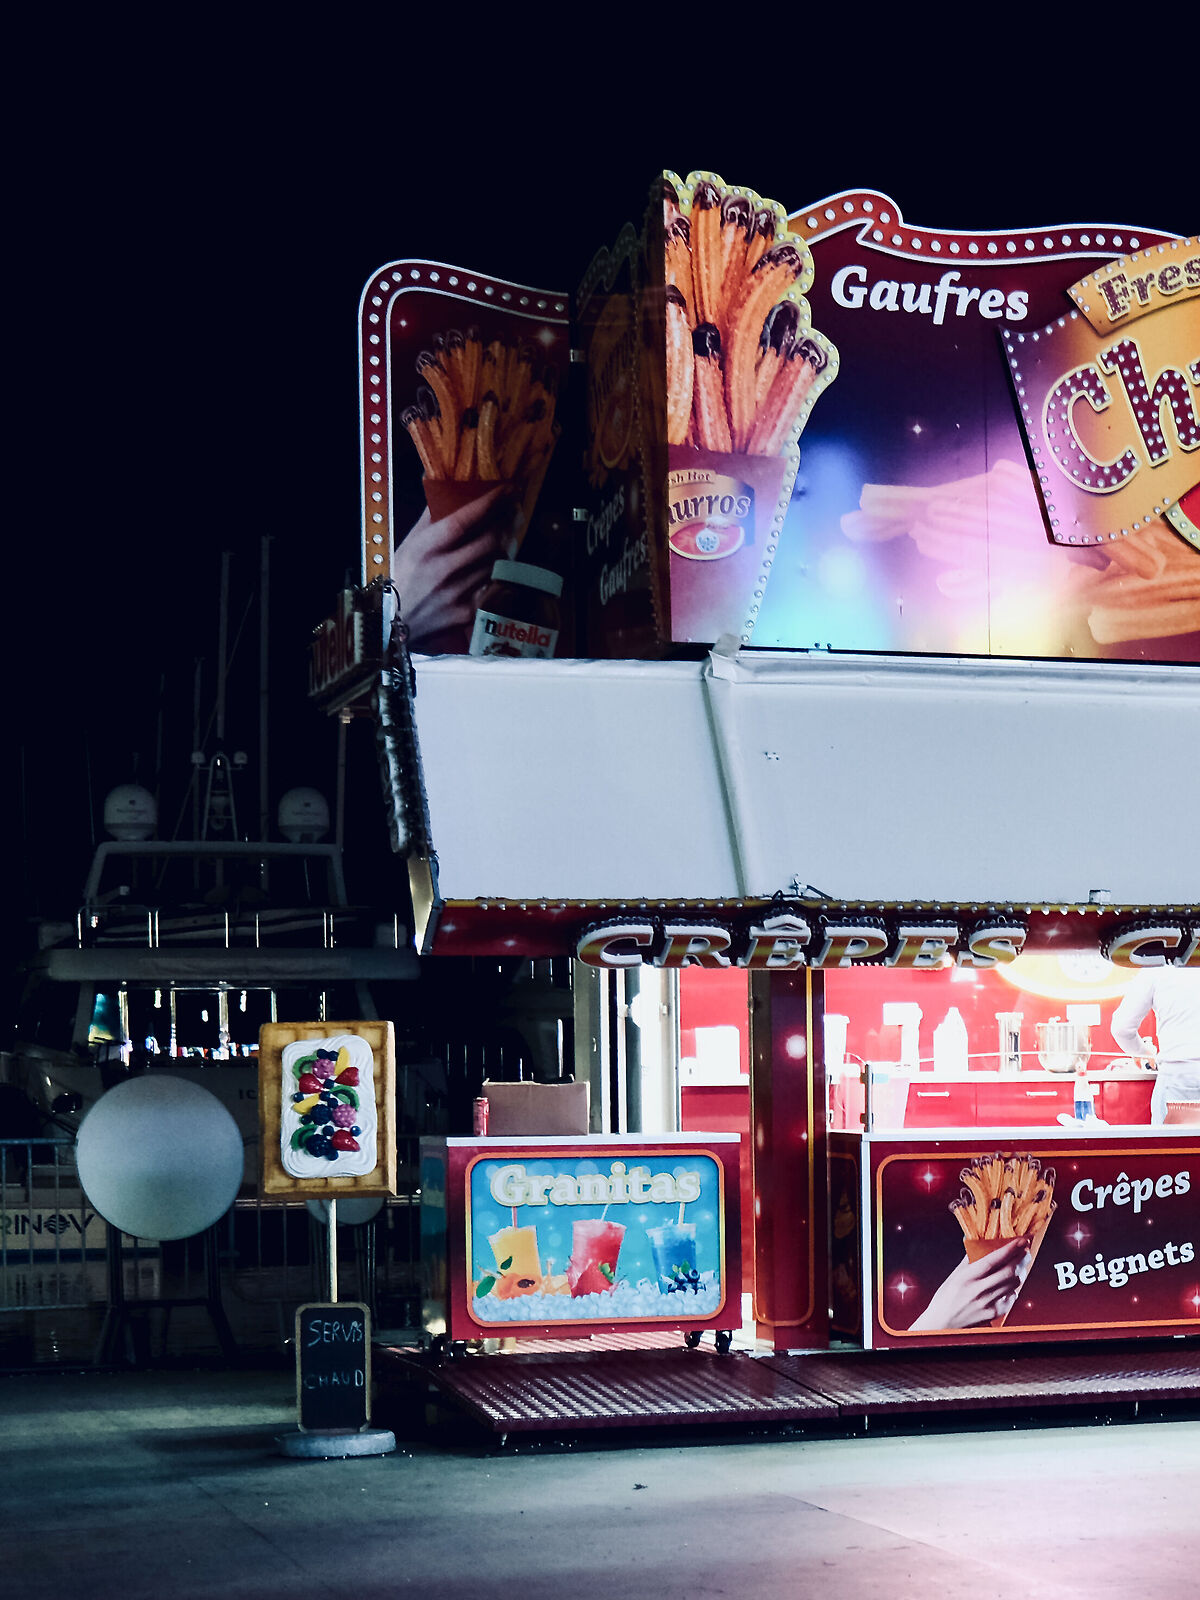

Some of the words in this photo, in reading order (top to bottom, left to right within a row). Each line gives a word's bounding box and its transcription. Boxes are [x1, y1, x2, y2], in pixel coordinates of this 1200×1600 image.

[830, 264, 1028, 325] Gaufres
[484, 617, 551, 648] nutella
[576, 912, 1027, 970] CRÊPES
[490, 1161, 701, 1207] Granitas
[1070, 1170, 1192, 1214] Crêpes
[1054, 1240, 1196, 1291] Beignets
